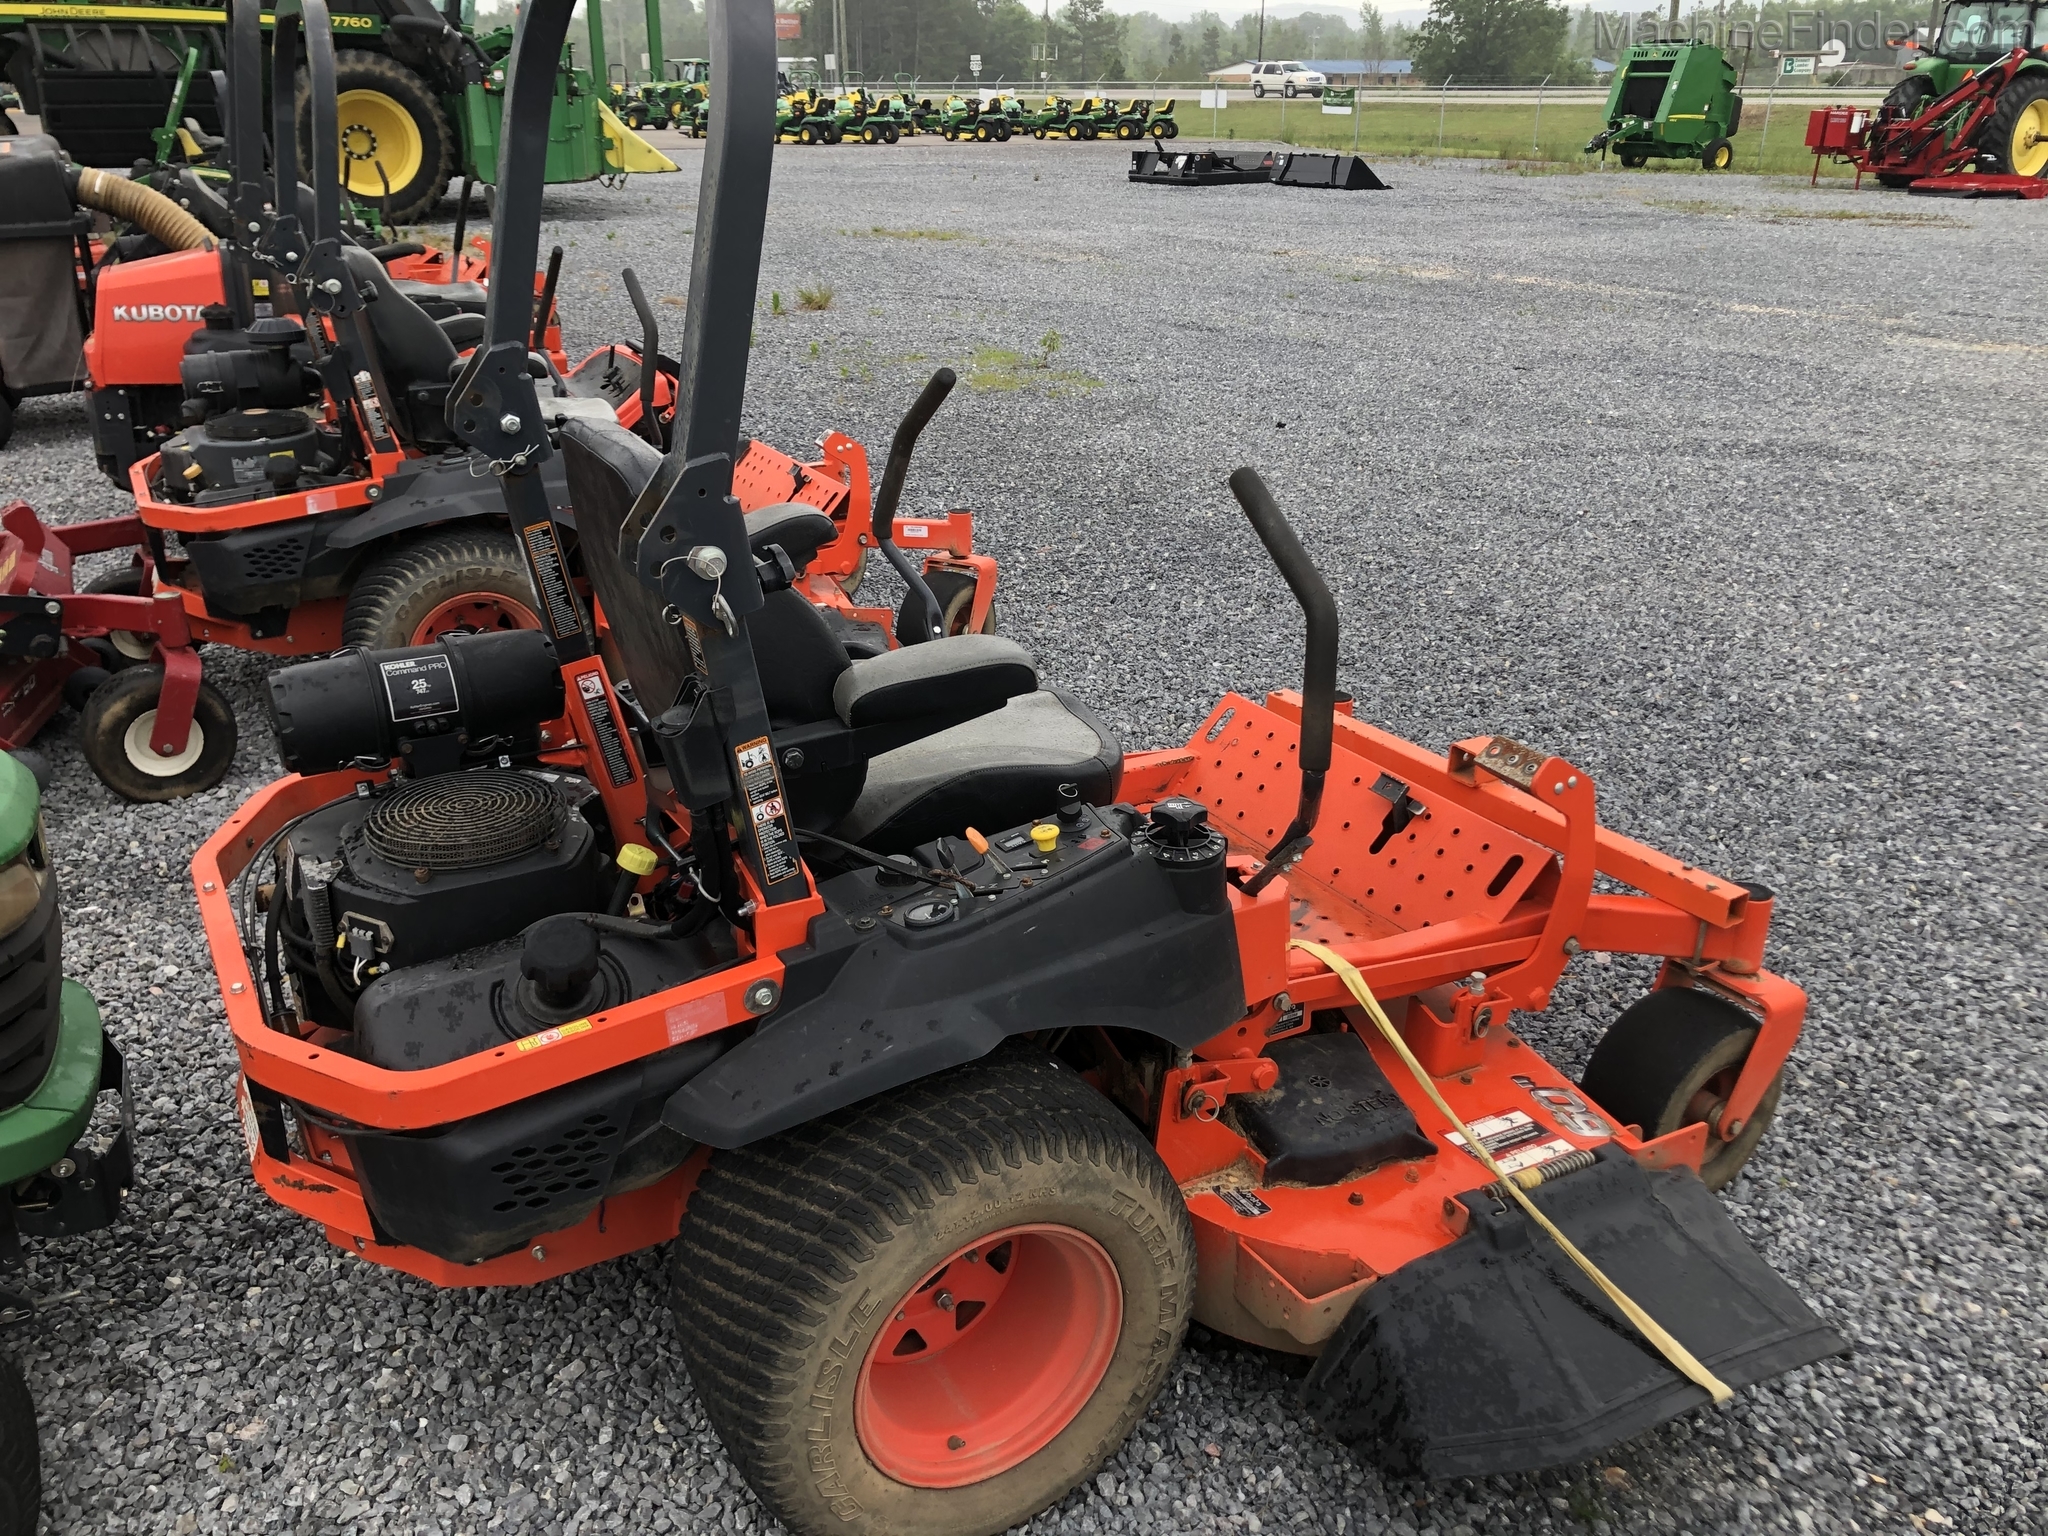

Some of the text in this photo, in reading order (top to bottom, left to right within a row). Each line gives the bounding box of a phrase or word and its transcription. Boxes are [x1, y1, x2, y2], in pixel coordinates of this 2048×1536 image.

[41, 7, 106, 16] JOHN DEERE
[330, 16, 373, 28] 7760
[395, 567, 518, 619] CARLISLE
[383, 661, 417, 671] KOHLER
[386, 661, 447, 676] Command PRO
[411, 678, 427, 690] 25
[742, 737, 767, 750] WARNING
[1314, 1110, 1345, 1126] NO
[1469, 1115, 1496, 1125] DANGER
[1510, 1143, 1538, 1154] PELIGRO
[1108, 1188, 1175, 1272] TURF
[806, 1286, 883, 1522] CARLISLE
